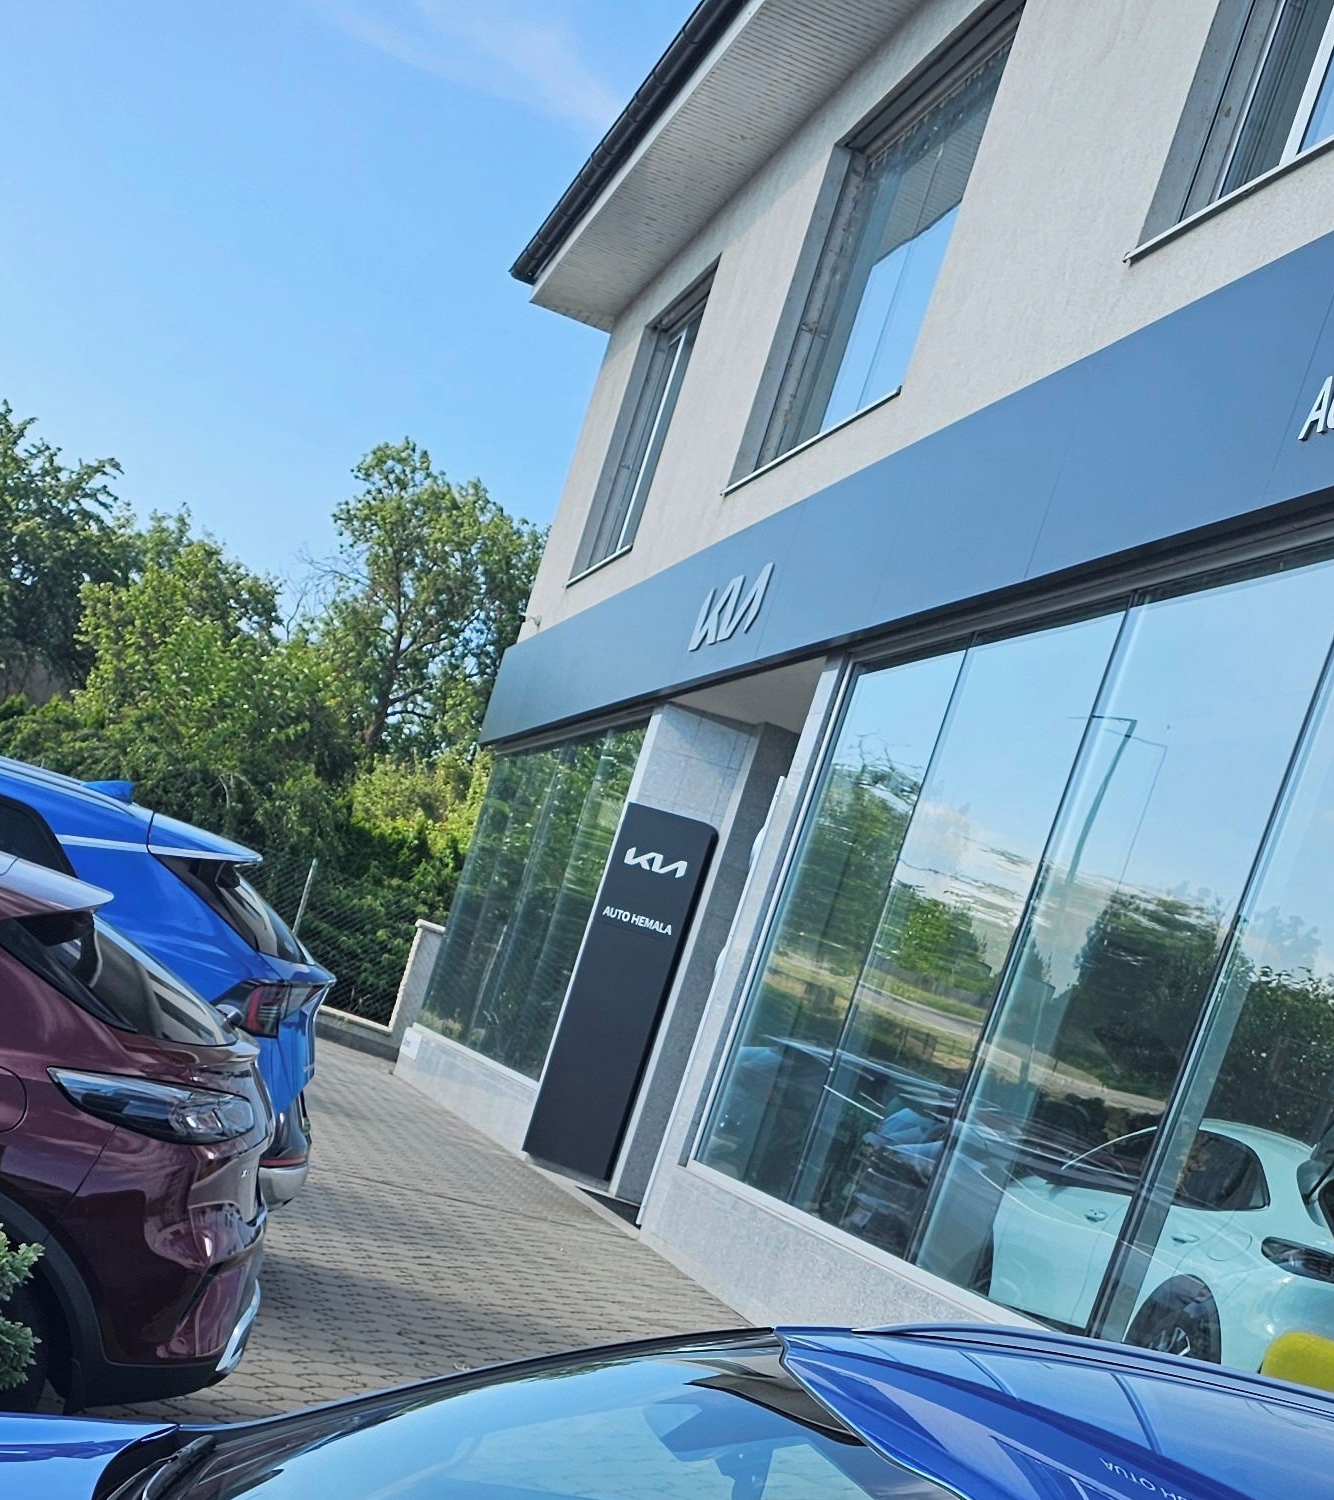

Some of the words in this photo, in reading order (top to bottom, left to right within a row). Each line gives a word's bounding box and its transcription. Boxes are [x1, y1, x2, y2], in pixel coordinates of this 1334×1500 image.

[687, 560, 774, 652] KIA
[624, 846, 688, 878] KIA
[602, 905, 631, 923] AUTO
[630, 913, 672, 936] HEMALA
